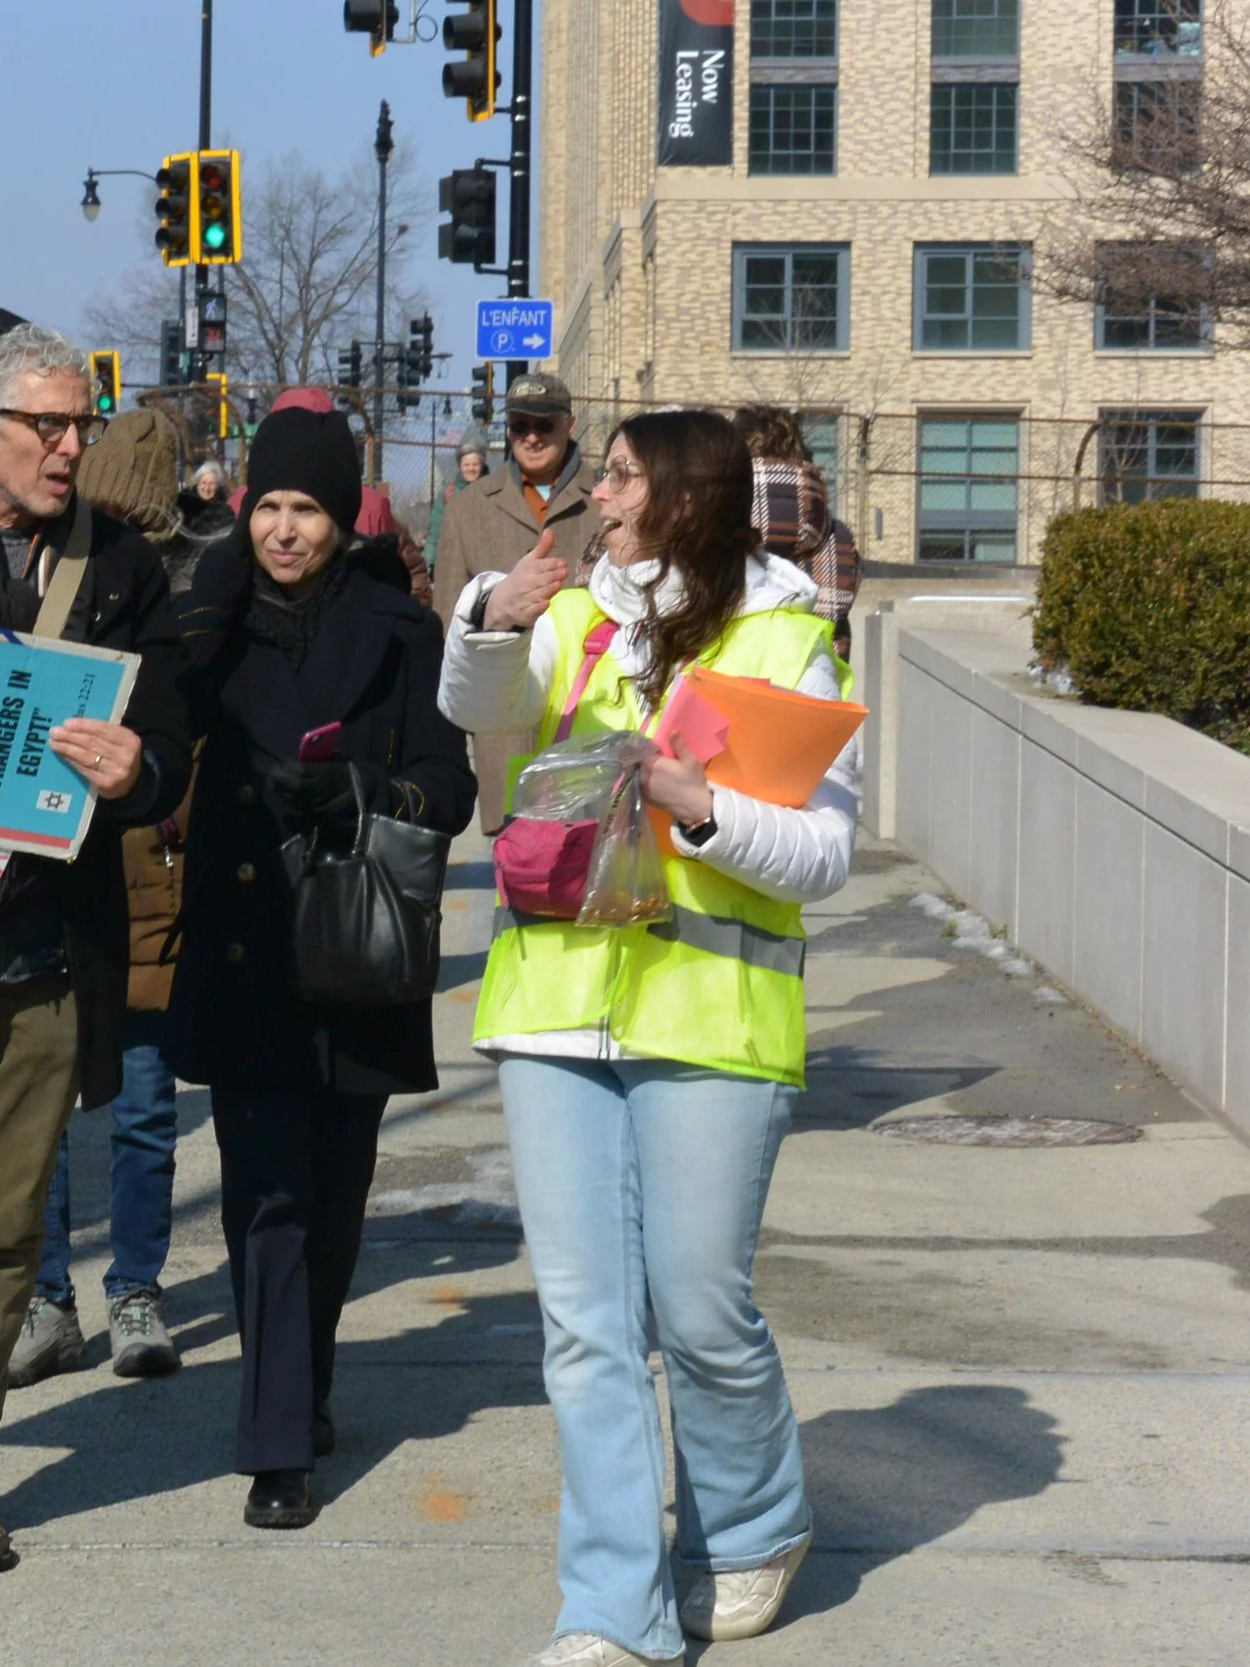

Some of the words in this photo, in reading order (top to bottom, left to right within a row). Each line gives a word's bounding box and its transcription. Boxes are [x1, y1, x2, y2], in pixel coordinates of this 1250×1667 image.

[668, 50, 700, 138] Leasing
[701, 50, 726, 104] Now
[481, 309, 547, 326] L'ENFANT
[7, 669, 33, 690] IN
